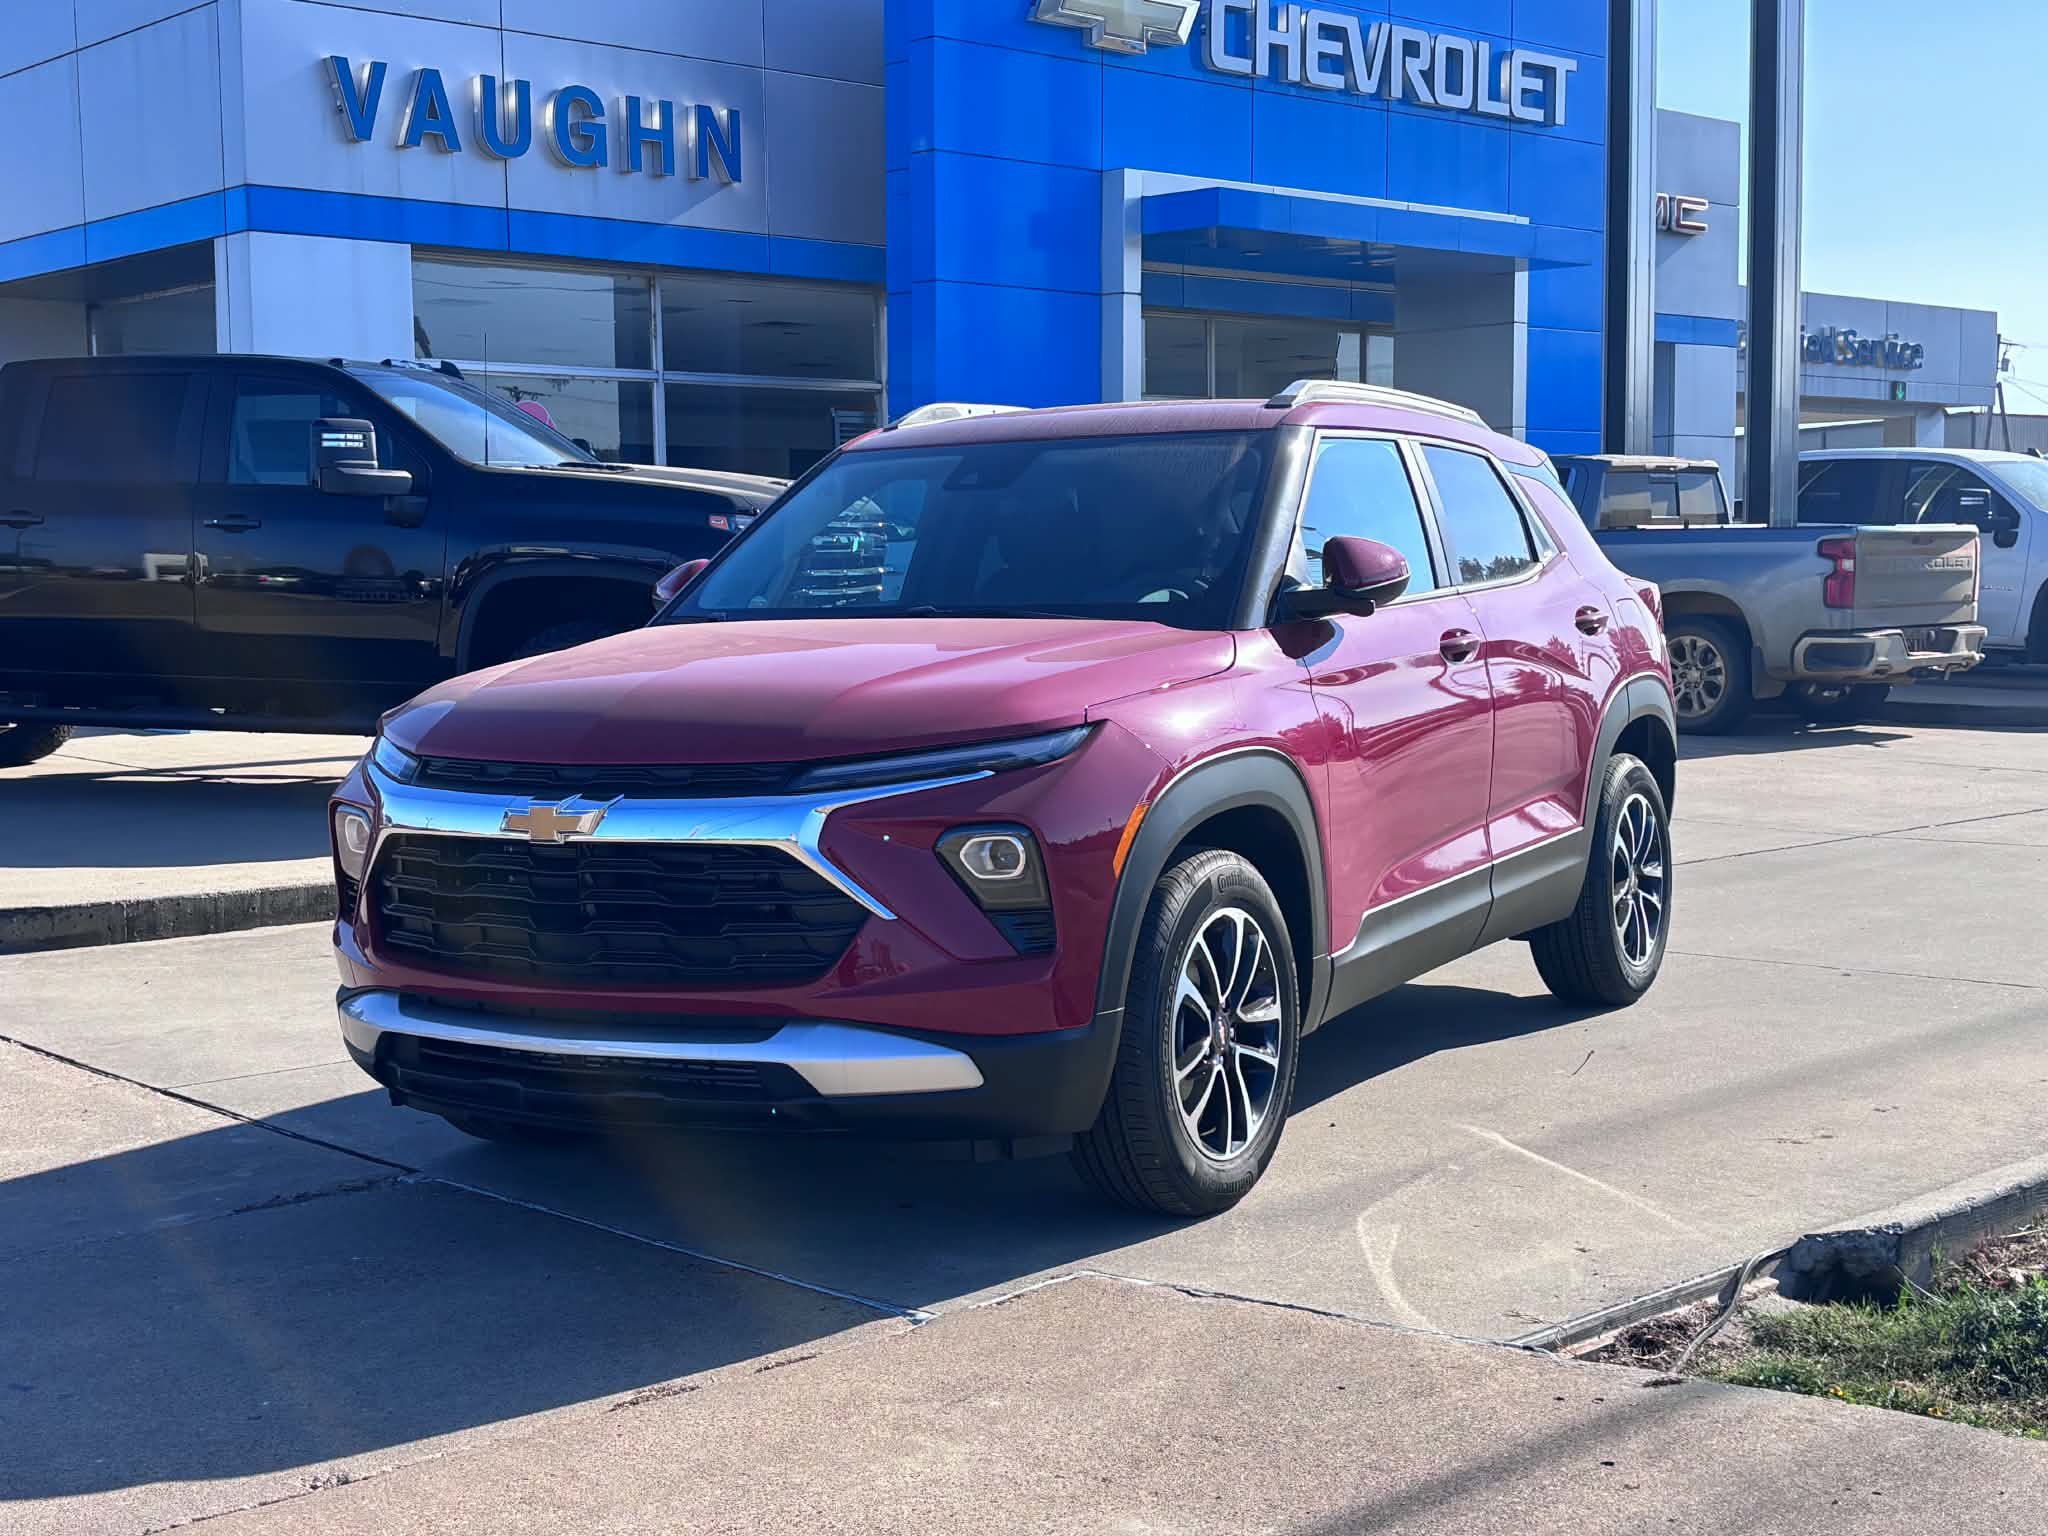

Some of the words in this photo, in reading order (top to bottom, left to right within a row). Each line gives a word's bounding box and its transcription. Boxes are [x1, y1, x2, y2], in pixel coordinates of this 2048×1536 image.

[323, 55, 742, 184] VAUGHN
[1207, 0, 1577, 126] CHEVROLET
[1839, 328, 1924, 369] Service
